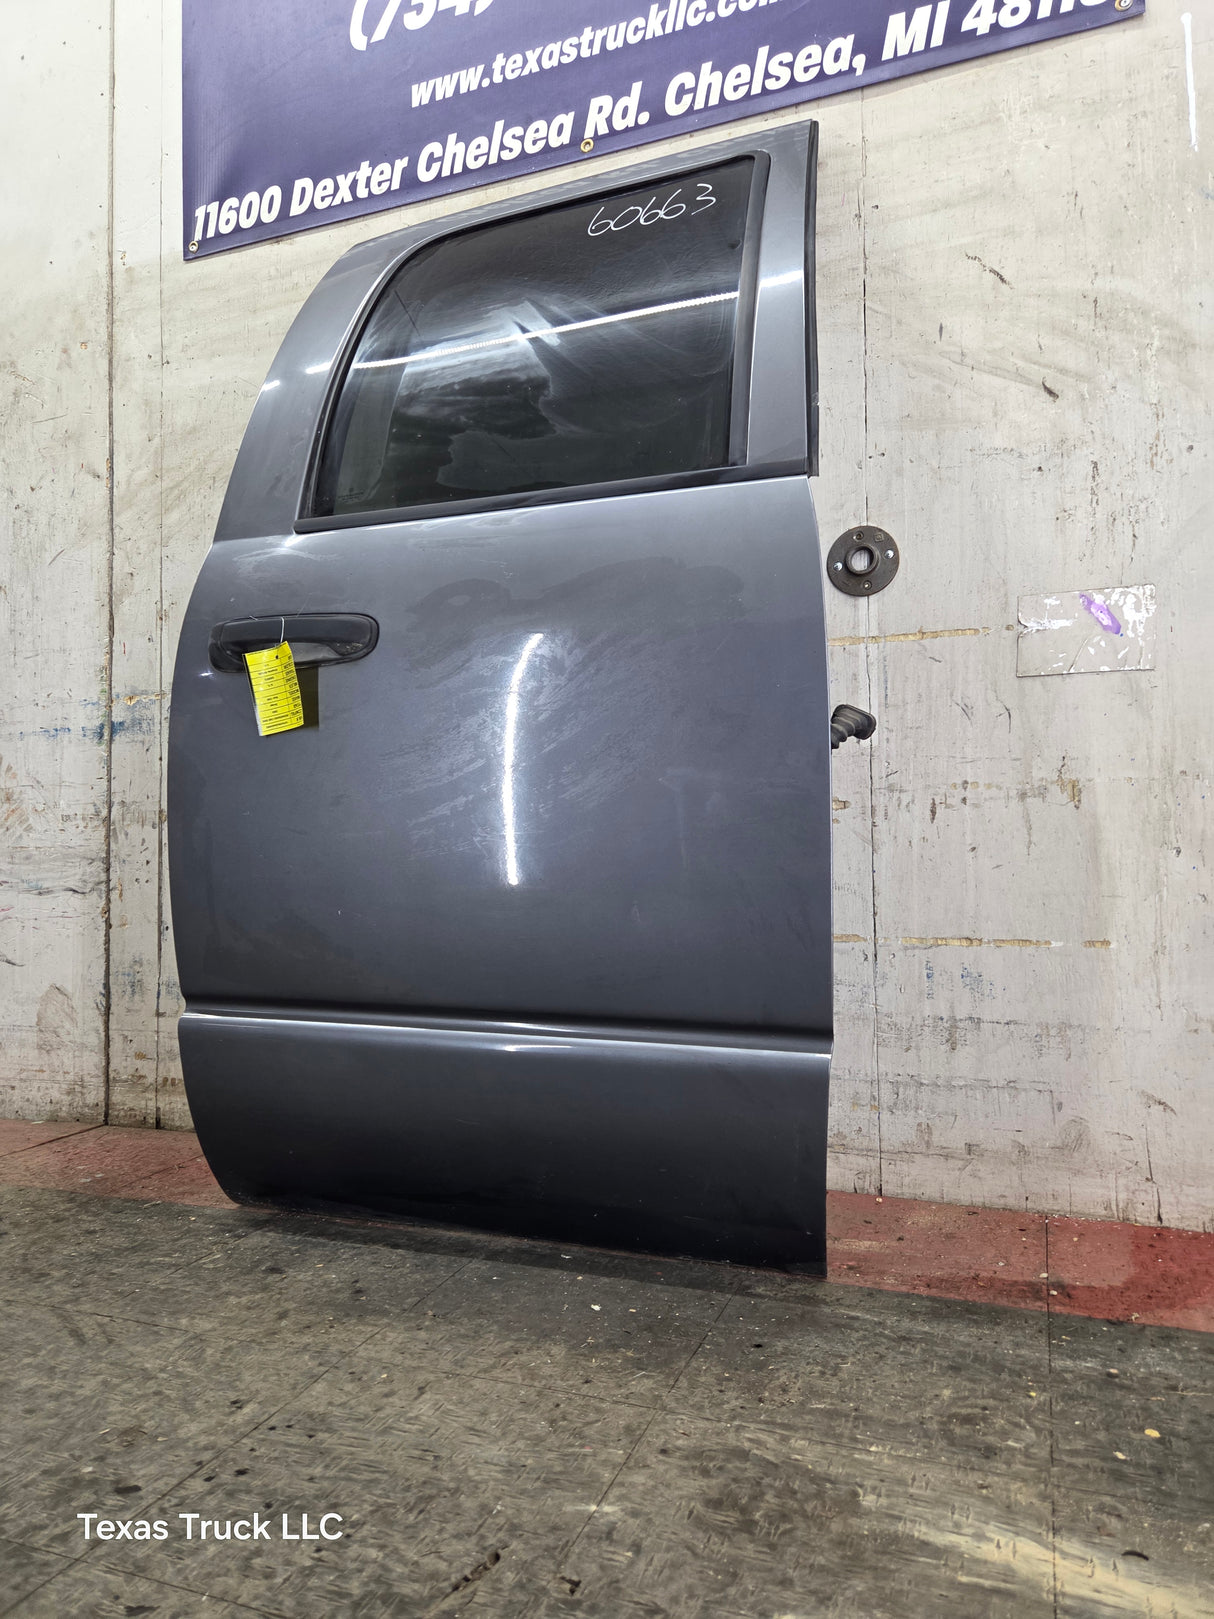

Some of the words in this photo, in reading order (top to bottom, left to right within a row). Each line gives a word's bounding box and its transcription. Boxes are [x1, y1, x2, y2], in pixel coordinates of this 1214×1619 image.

[411, 0, 783, 107] www.texastruckllc.c
[194, 186, 283, 241] 11600
[289, 157, 408, 217] Dexter
[417, 111, 575, 183] Chelsea
[584, 81, 650, 139] Rd.
[664, 34, 867, 117] Chelsea,
[881, 0, 949, 61] MI
[587, 183, 717, 237] 60663
